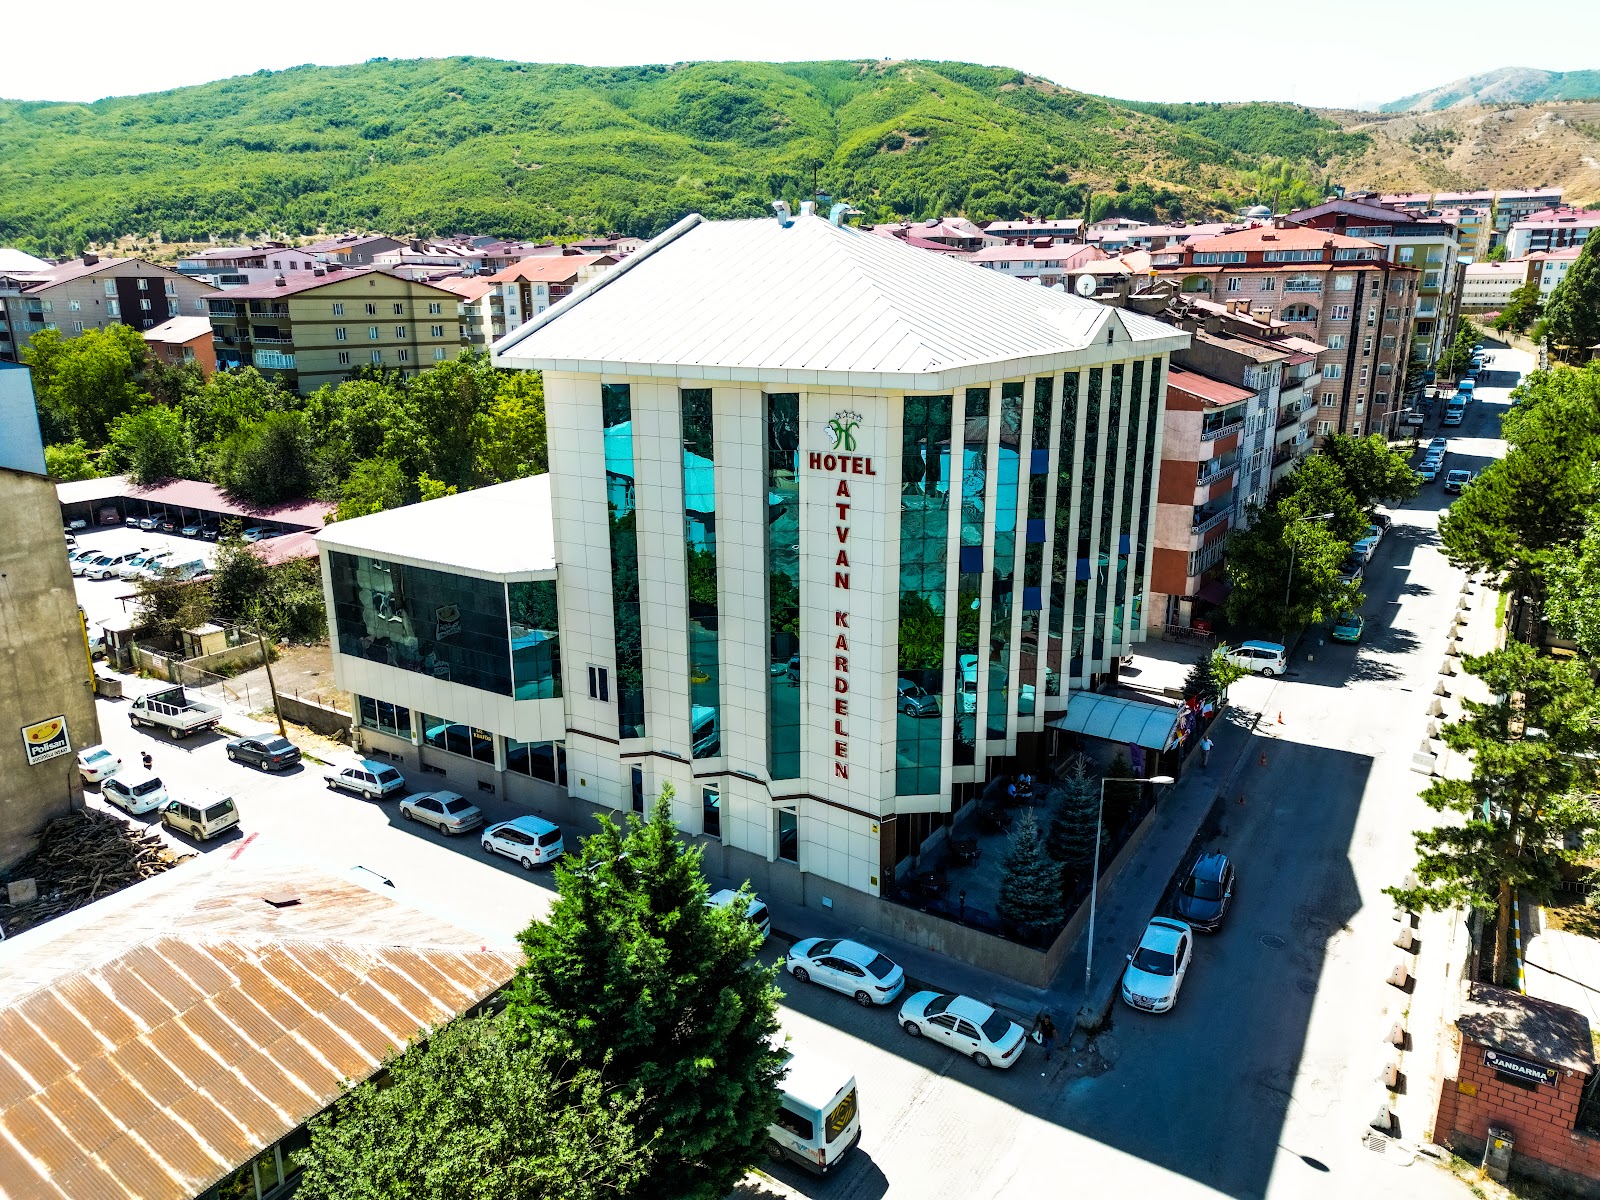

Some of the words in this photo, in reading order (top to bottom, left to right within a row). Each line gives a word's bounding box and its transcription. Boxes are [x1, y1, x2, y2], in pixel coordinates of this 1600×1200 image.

[809, 452, 876, 476] HOTEL
[834, 610, 850, 780] KARDELEN
[31, 739, 65, 756] Polisan
[1492, 1058, 1548, 1080] JANDARMA
